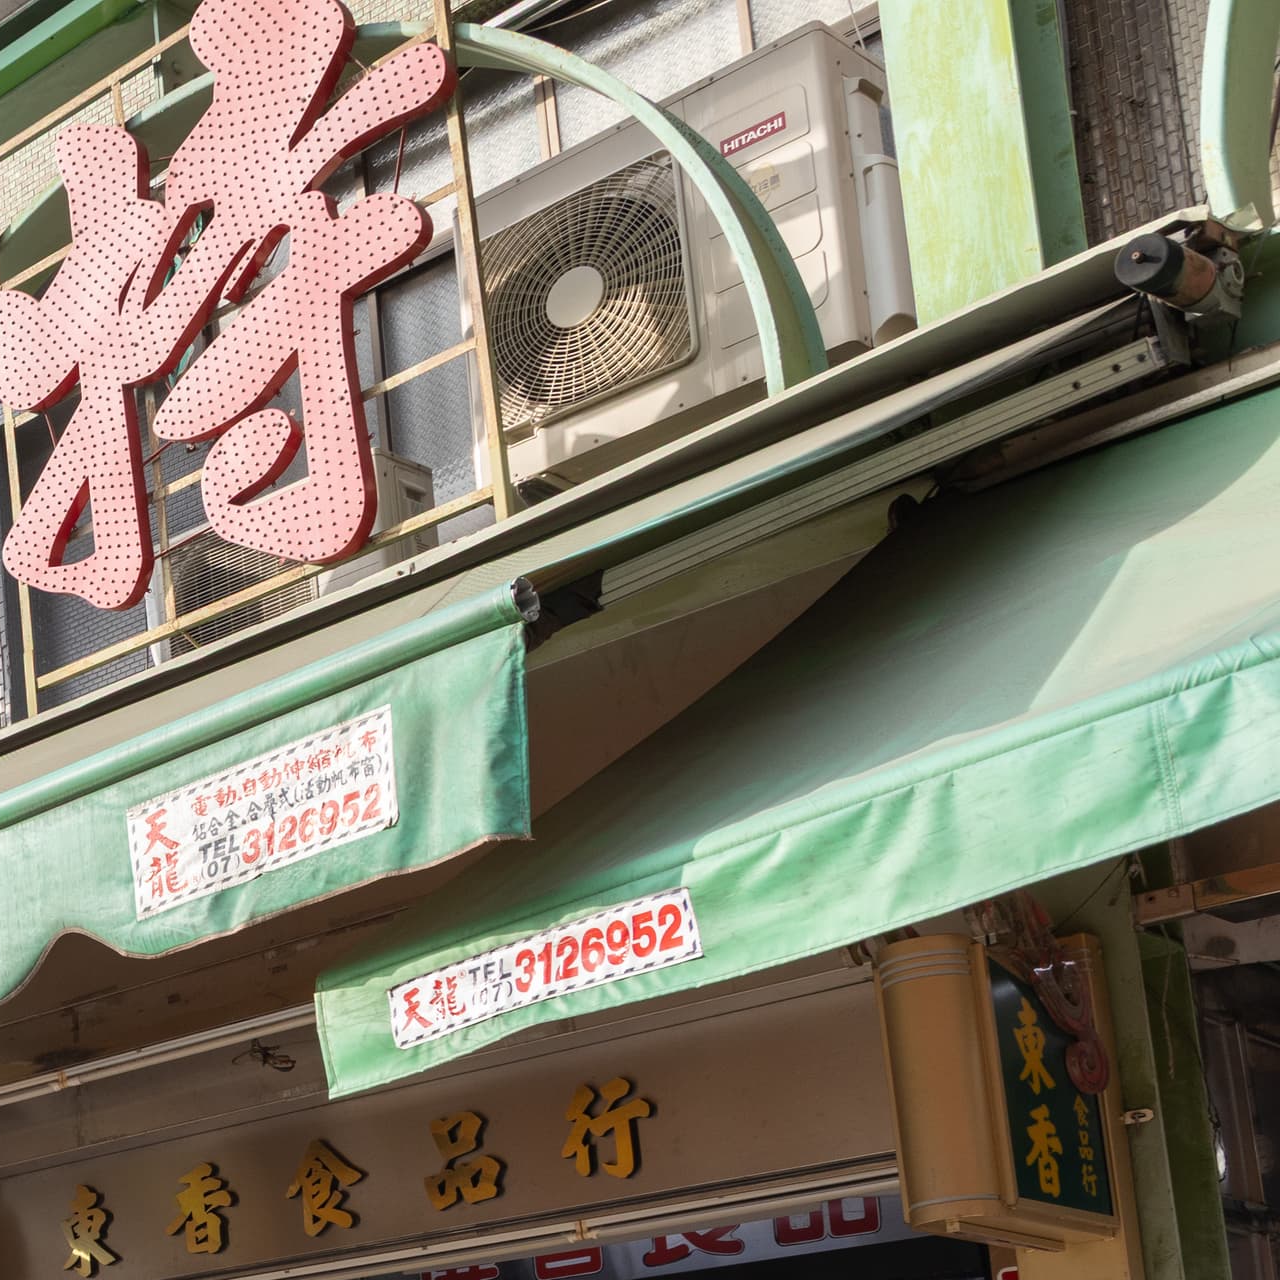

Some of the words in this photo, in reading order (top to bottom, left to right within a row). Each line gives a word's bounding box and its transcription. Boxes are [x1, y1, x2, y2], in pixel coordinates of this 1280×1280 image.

[722, 116, 785, 153] HITACHI
[143, 807, 189, 898] 天龍
[199, 835, 241, 863] TEL
[241, 783, 382, 864] 3126952
[201, 855, 241, 879] (07)
[468, 958, 513, 987] TEL
[515, 903, 684, 993] 3126952
[401, 972, 466, 1031] 天龍
[1012, 995, 1064, 1198] 東香
[62, 1076, 652, 1278] 東香食品行
[1073, 1095, 1098, 1198] 食品行
